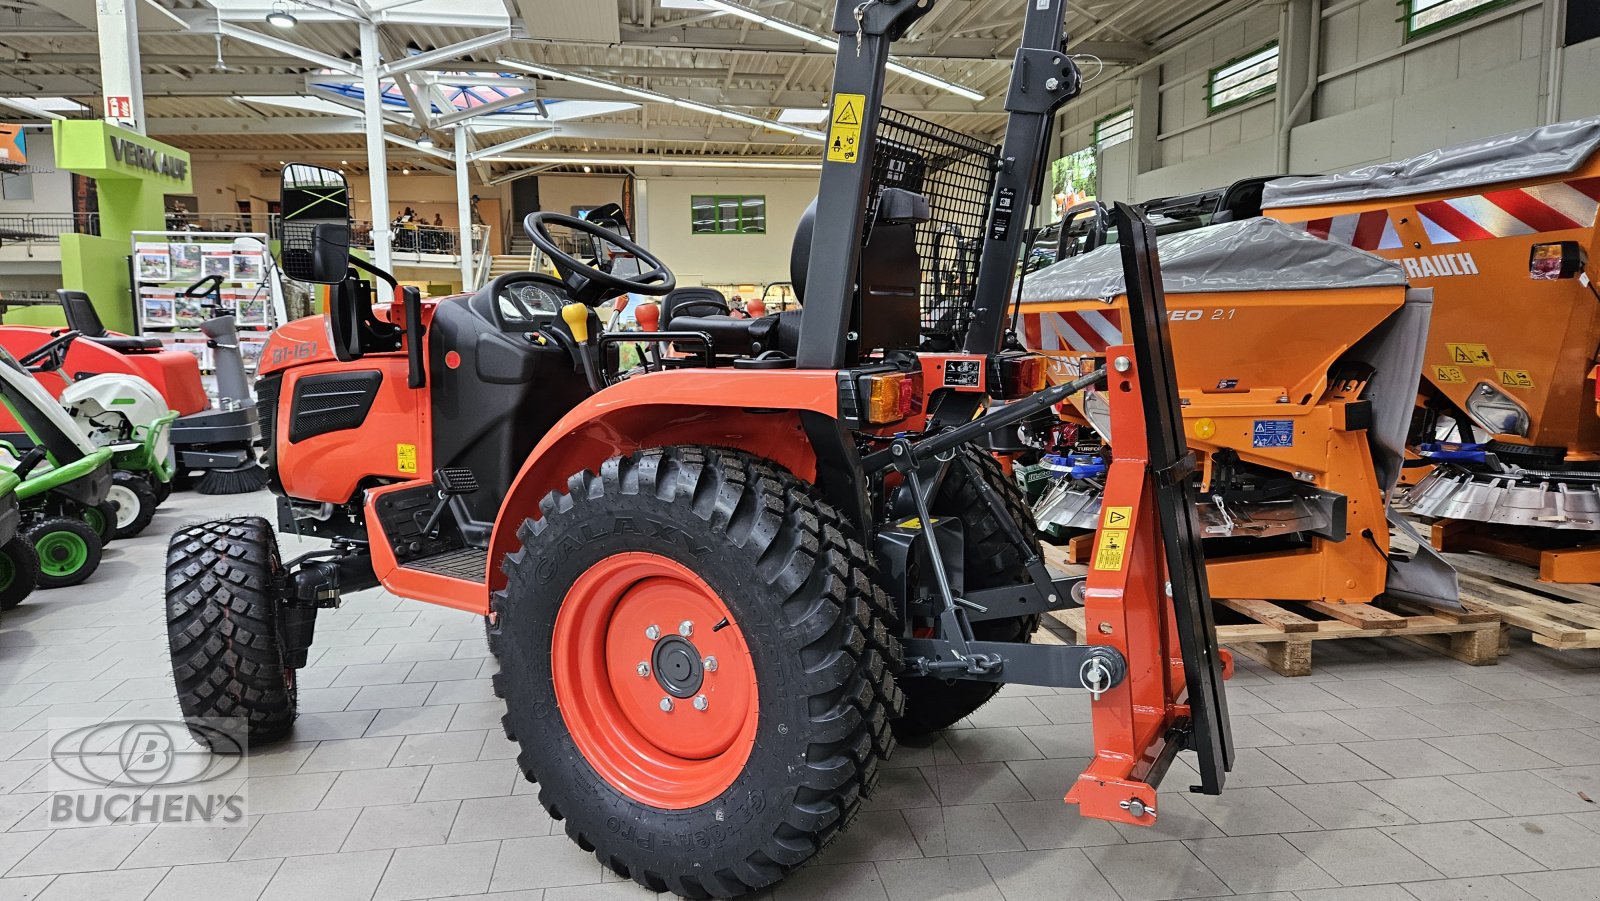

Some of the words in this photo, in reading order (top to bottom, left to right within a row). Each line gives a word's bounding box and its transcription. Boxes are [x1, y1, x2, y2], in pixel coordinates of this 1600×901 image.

[1402, 252, 1480, 279] RAUCH
[1211, 308, 1236, 320] 2.1
[272, 341, 318, 365] B1-161
[534, 516, 713, 585] GALAXY
